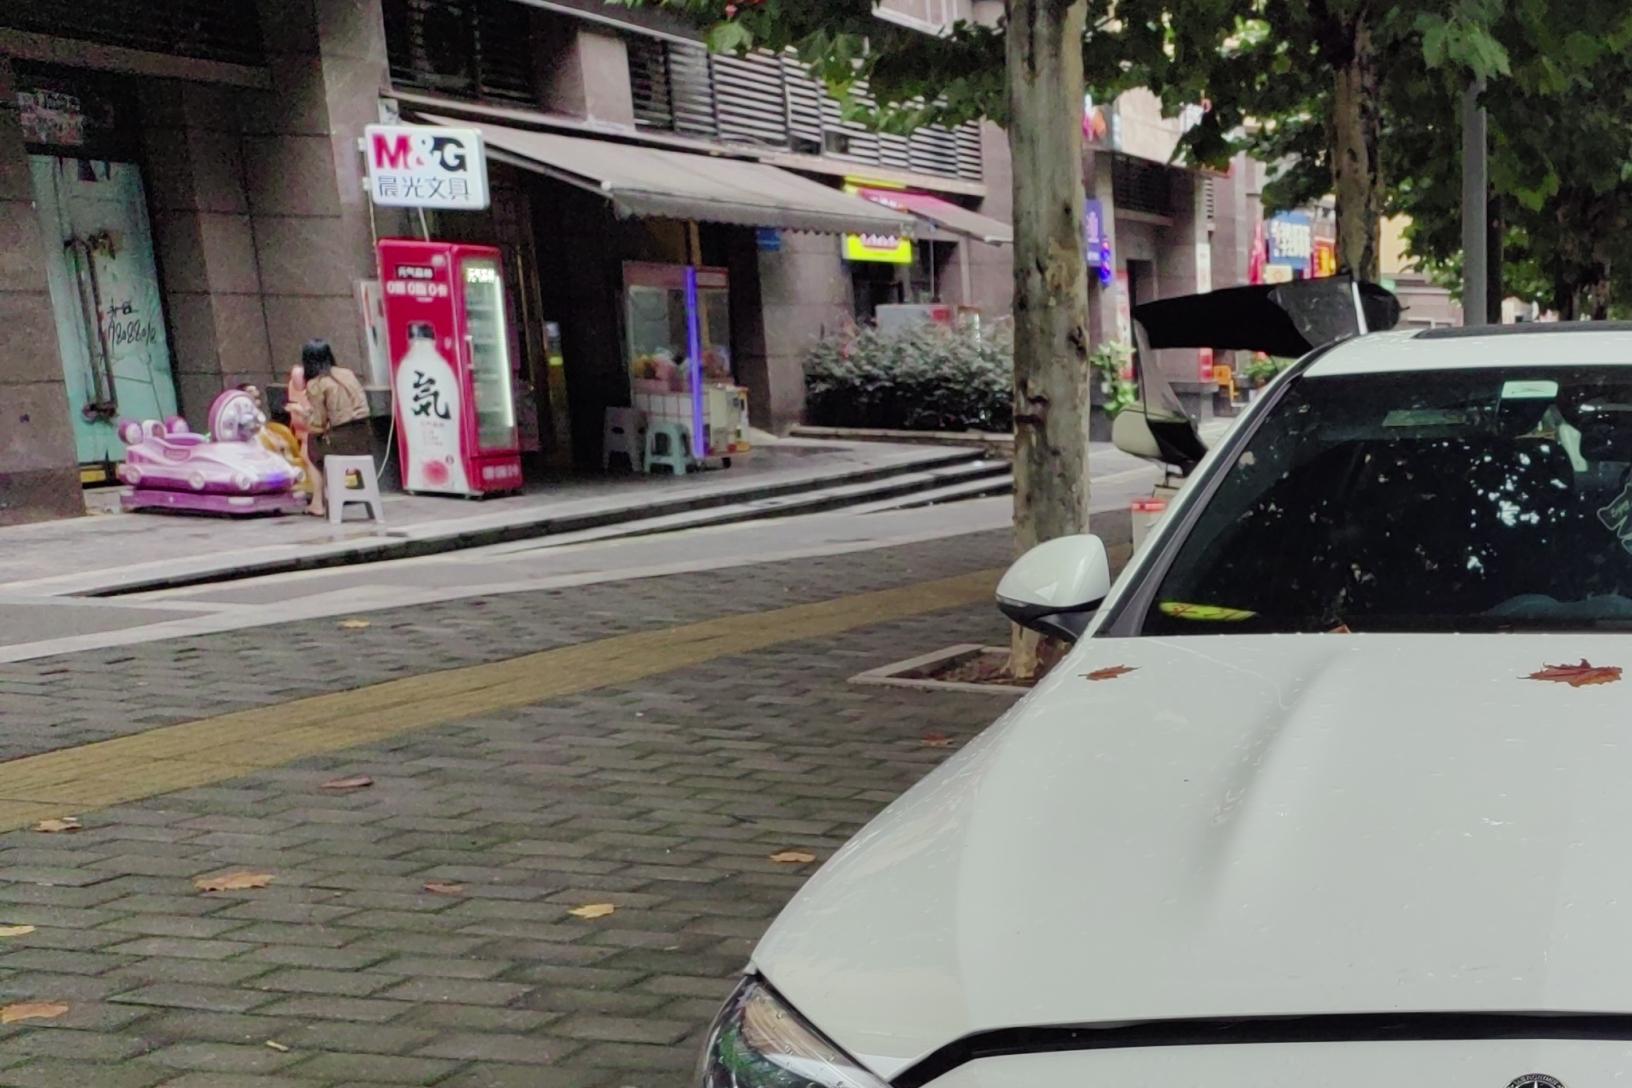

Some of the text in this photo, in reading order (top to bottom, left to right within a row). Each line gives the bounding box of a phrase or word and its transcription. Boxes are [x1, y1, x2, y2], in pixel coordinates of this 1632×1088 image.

[372, 133, 468, 173] M&G
[377, 175, 471, 200] 晨光文具
